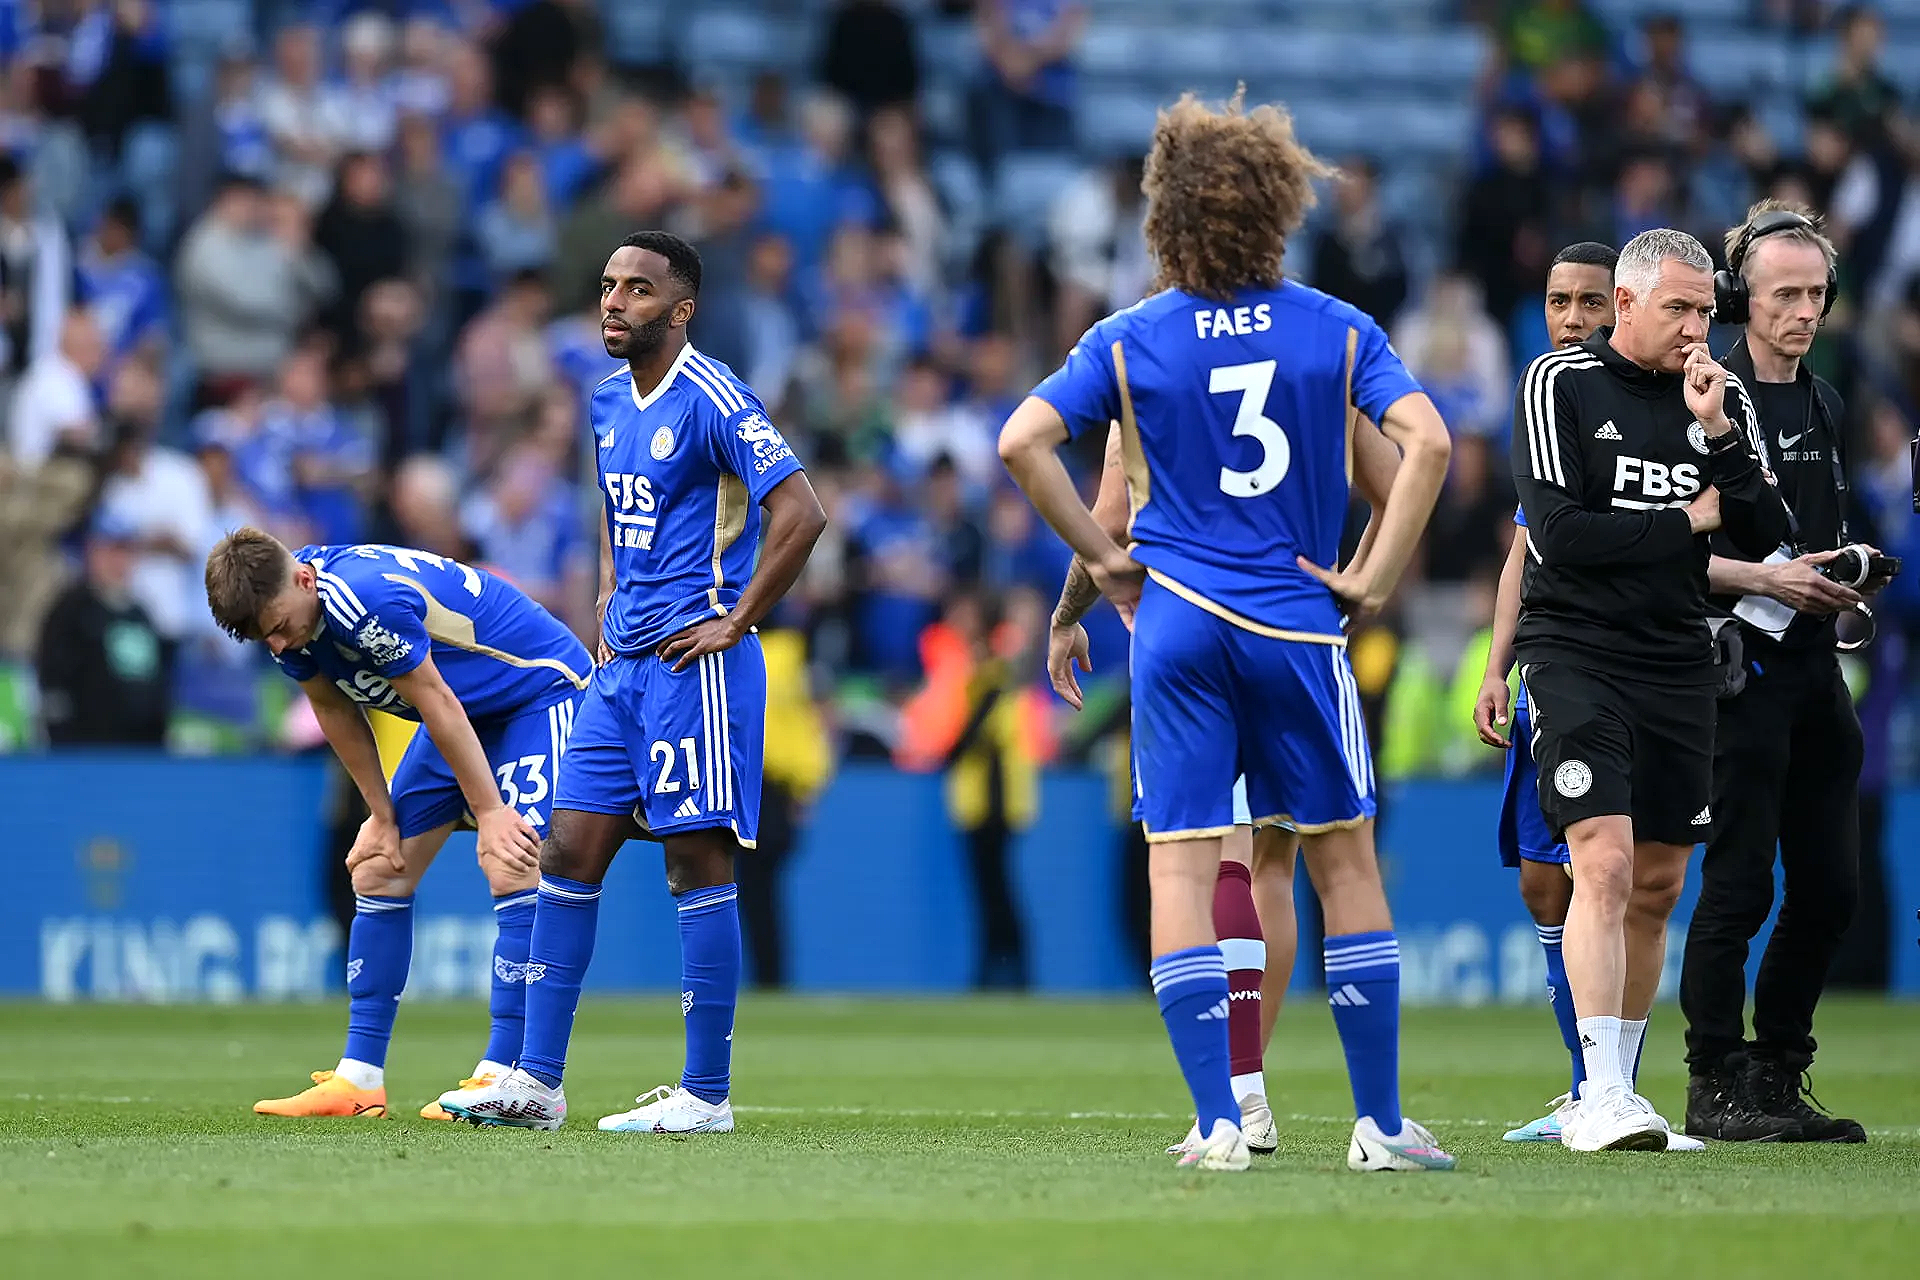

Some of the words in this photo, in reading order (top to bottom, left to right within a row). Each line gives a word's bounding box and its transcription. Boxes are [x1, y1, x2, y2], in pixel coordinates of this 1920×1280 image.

[1195, 304, 1272, 329] FAES
[1208, 359, 1291, 498] 3
[1594, 431, 1623, 441] adidas
[604, 472, 656, 513] FBS
[1613, 455, 1700, 498] FBS
[497, 754, 549, 809] 33
[650, 737, 700, 794] 21
[40, 914, 244, 1004] KING
